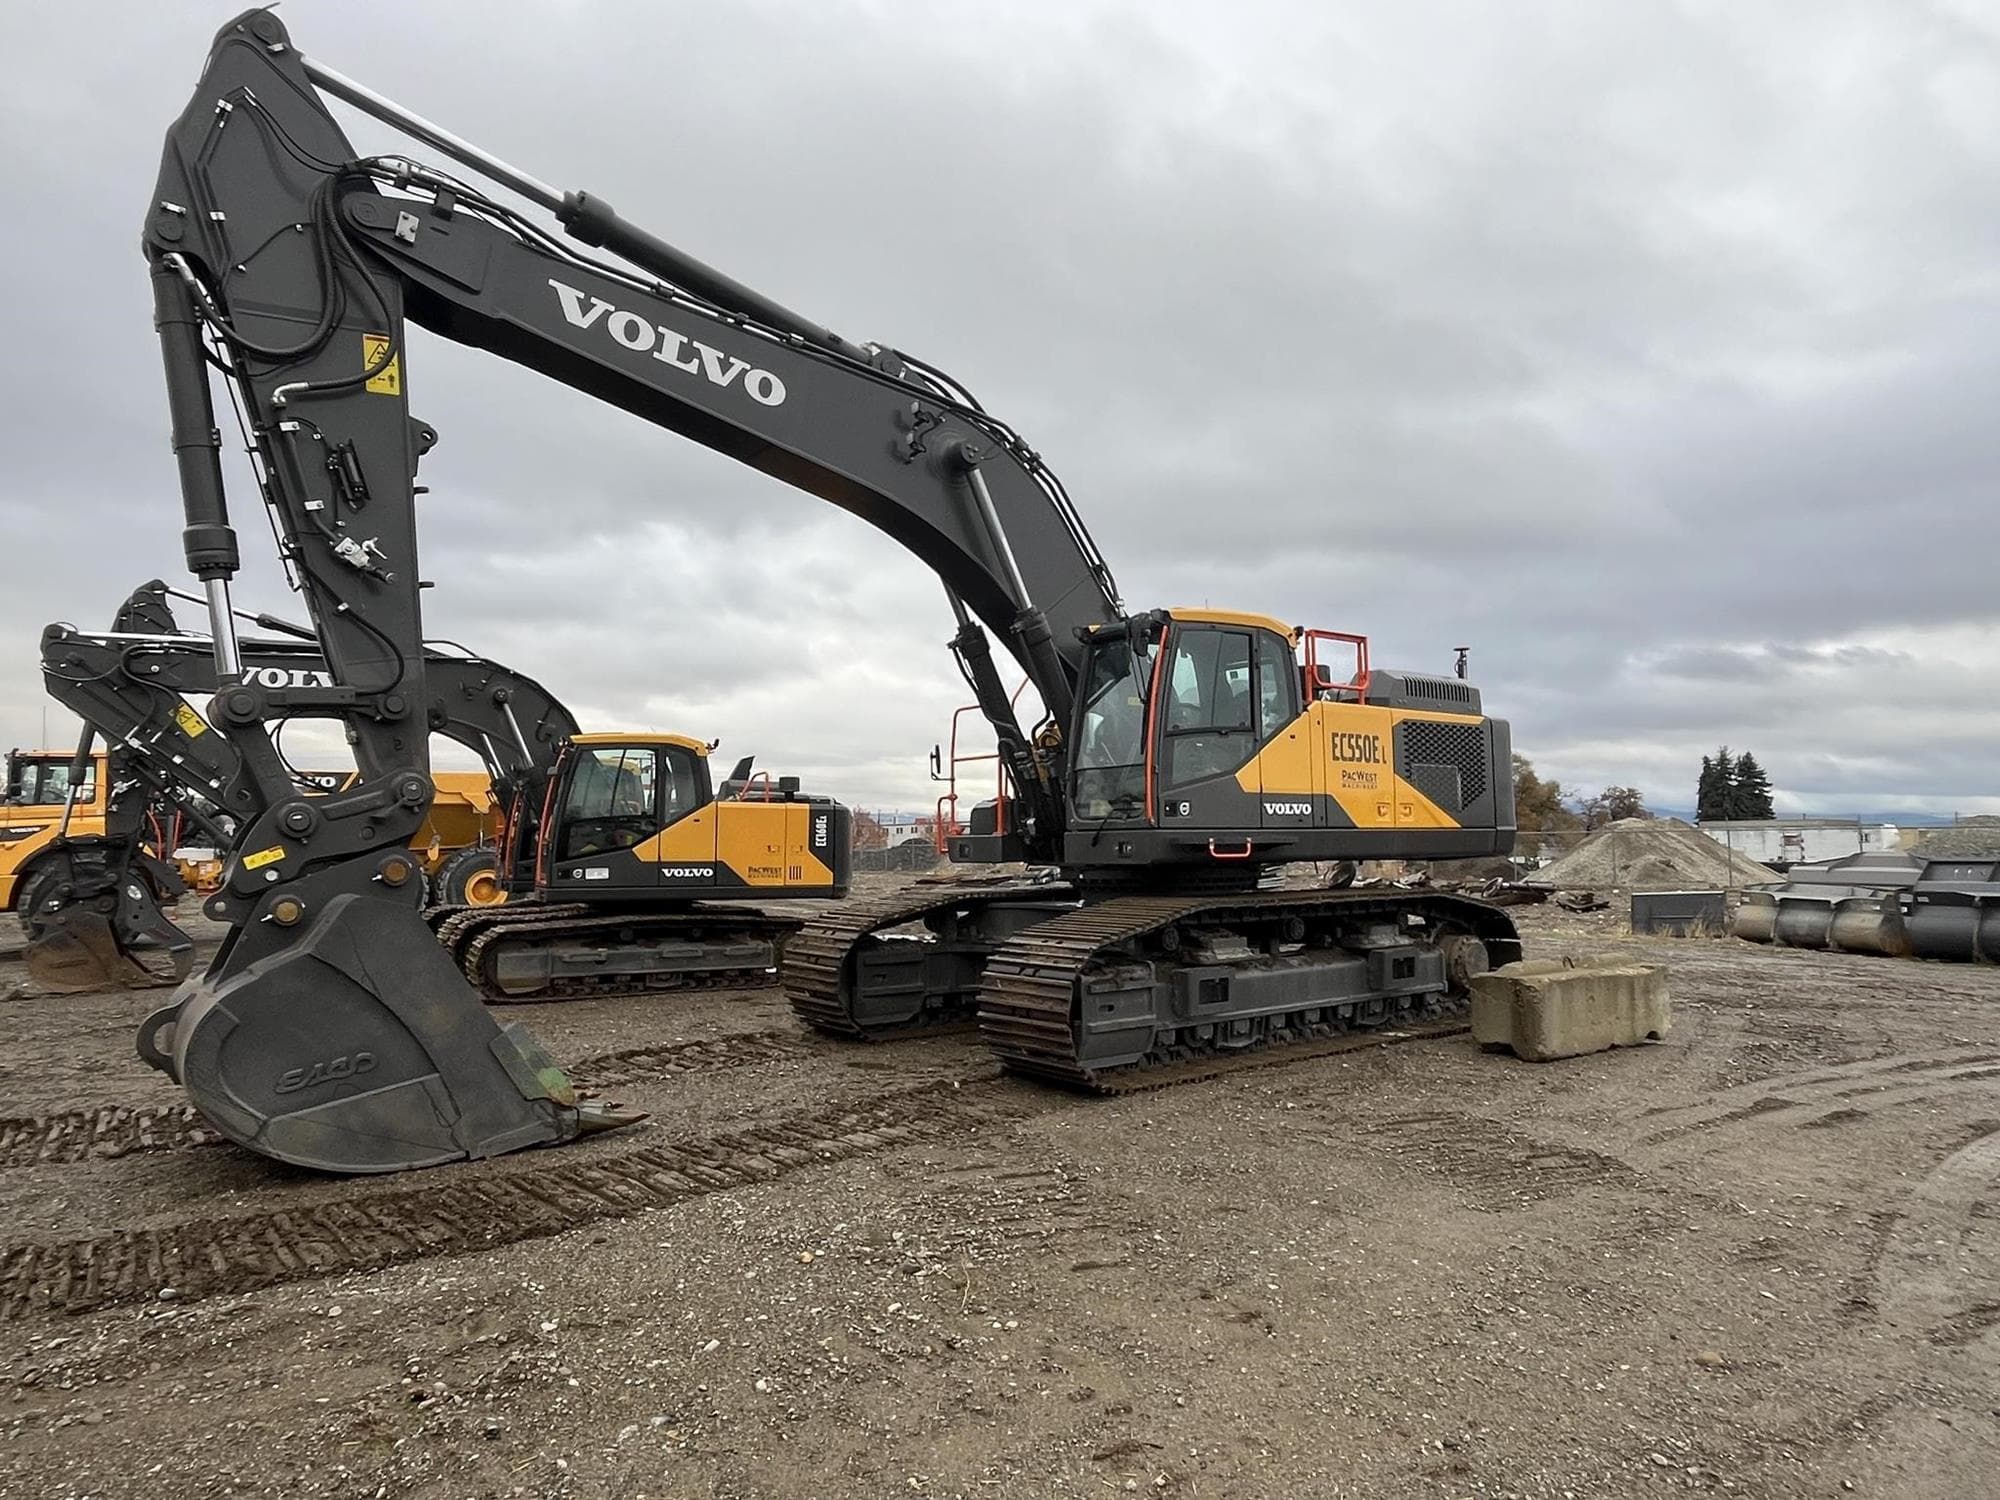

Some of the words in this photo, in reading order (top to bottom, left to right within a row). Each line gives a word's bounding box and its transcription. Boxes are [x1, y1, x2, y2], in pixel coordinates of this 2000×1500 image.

[548, 278, 787, 406] VOLVO
[1264, 803, 1312, 815] VOLVO
[662, 868, 713, 877] VOLVO
